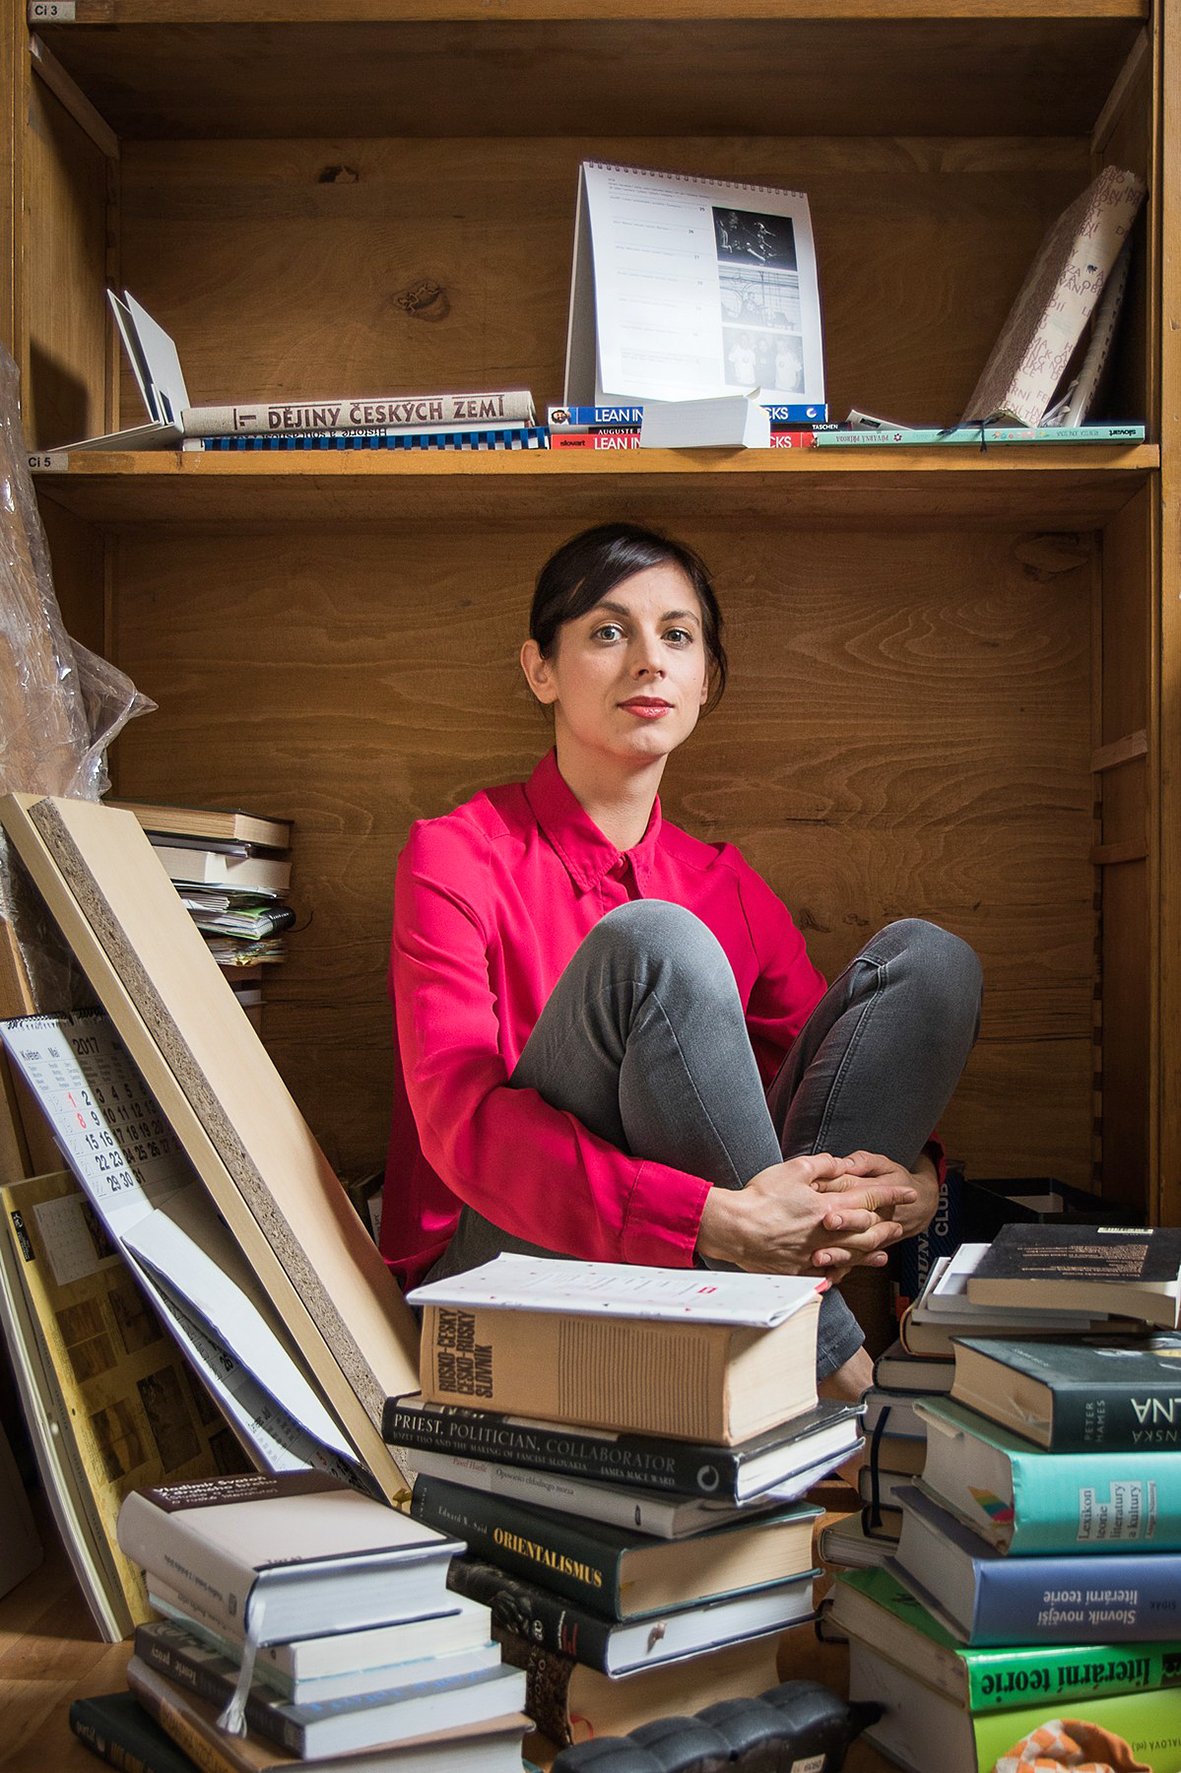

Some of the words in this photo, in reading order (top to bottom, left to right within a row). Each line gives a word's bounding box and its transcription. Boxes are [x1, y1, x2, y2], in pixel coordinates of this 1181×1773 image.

[34, 5, 47, 16] Ci
[51, 5, 58, 16] 3
[268, 406, 341, 429] DĚJINY
[349, 401, 443, 425] ČESKÝCH
[452, 394, 505, 418] ZEMÍ
[595, 409, 630, 422] LEAN
[594, 438, 628, 450] LEAN
[1108, 429, 1137, 437] slovart
[28, 457, 41, 468] Ci
[44, 457, 51, 467] 5
[73, 1037, 100, 1056] 2017
[81, 1090, 91, 1106] 2
[96, 1088, 105, 1103] 3
[111, 1085, 119, 1100] 4
[124, 1083, 133, 1098] 5
[77, 1113, 87, 1129] 8
[90, 1111, 100, 1126] 9
[103, 1108, 116, 1124] 10
[118, 1105, 130, 1121] 11
[131, 1102, 143, 1118] 12
[85, 1134, 99, 1150] 15
[100, 1131, 114, 1148] 16
[126, 1125, 139, 1141] 18
[139, 1122, 152, 1138] 19
[95, 1155, 110, 1171] 22
[109, 1151, 124, 1168] 23
[134, 1144, 148, 1161] 25
[107, 1175, 121, 1192] 29
[119, 1171, 134, 1188] 30
[935, 1183, 949, 1236] CLUB
[1084, 1402, 1094, 1440] PETER
[1096, 1400, 1106, 1442] HAMES
[435, 1438, 451, 1448] AND
[453, 1441, 467, 1450] THE
[546, 1439, 675, 1473] COLLABORATOR
[1078, 1490, 1092, 1539] Lexikon
[1109, 1483, 1126, 1538] literatury
[1127, 1484, 1142, 1529] kultury
[1096, 1505, 1108, 1538] teorie
[493, 1527, 602, 1588] ORIENTALISMUS
[1043, 1590, 1082, 1606] teorie
[1085, 1590, 1138, 1606] literární
[1037, 1607, 1084, 1626] novější
[1088, 1609, 1136, 1625] Slovník
[981, 1663, 1051, 1702] teorie
[1057, 1656, 1151, 1693] literární
